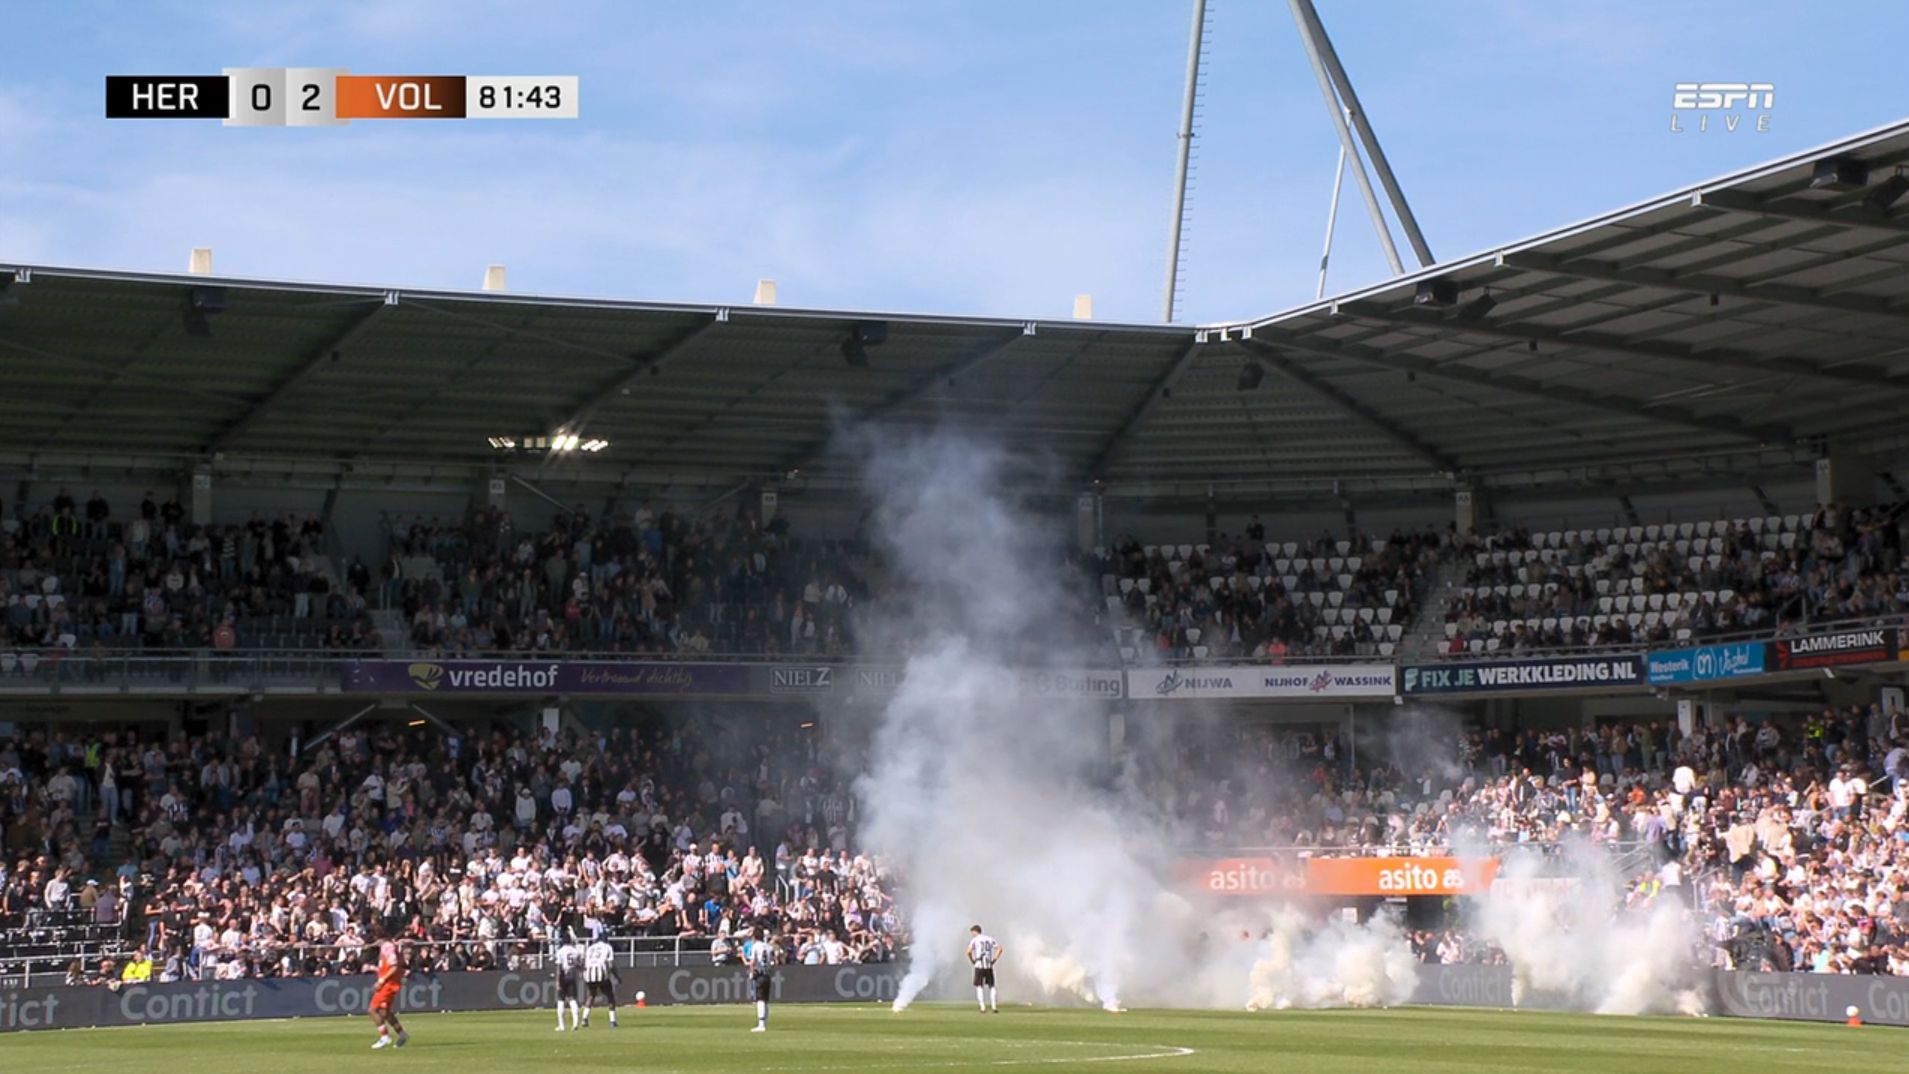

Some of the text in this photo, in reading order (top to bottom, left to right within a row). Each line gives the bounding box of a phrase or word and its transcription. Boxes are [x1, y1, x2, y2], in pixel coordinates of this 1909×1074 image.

[1790, 631, 1885, 654] LAMMERINK
[449, 665, 558, 687] vredehof
[773, 667, 831, 687] NIELZ
[860, 671, 898, 688] NIEL
[1185, 677, 1233, 689] NIJWA
[1264, 676, 1392, 688] NIJHOF WASSINK
[1421, 670, 1451, 688] FIX
[1454, 669, 1475, 686] JE
[1477, 662, 1637, 685] WERKKLEDING.NL
[1209, 863, 1275, 890] asito
[1379, 862, 1438, 890] asito
[314, 977, 442, 1012] Conict
[668, 969, 785, 1001] Contit
[120, 983, 257, 1021] Contict
